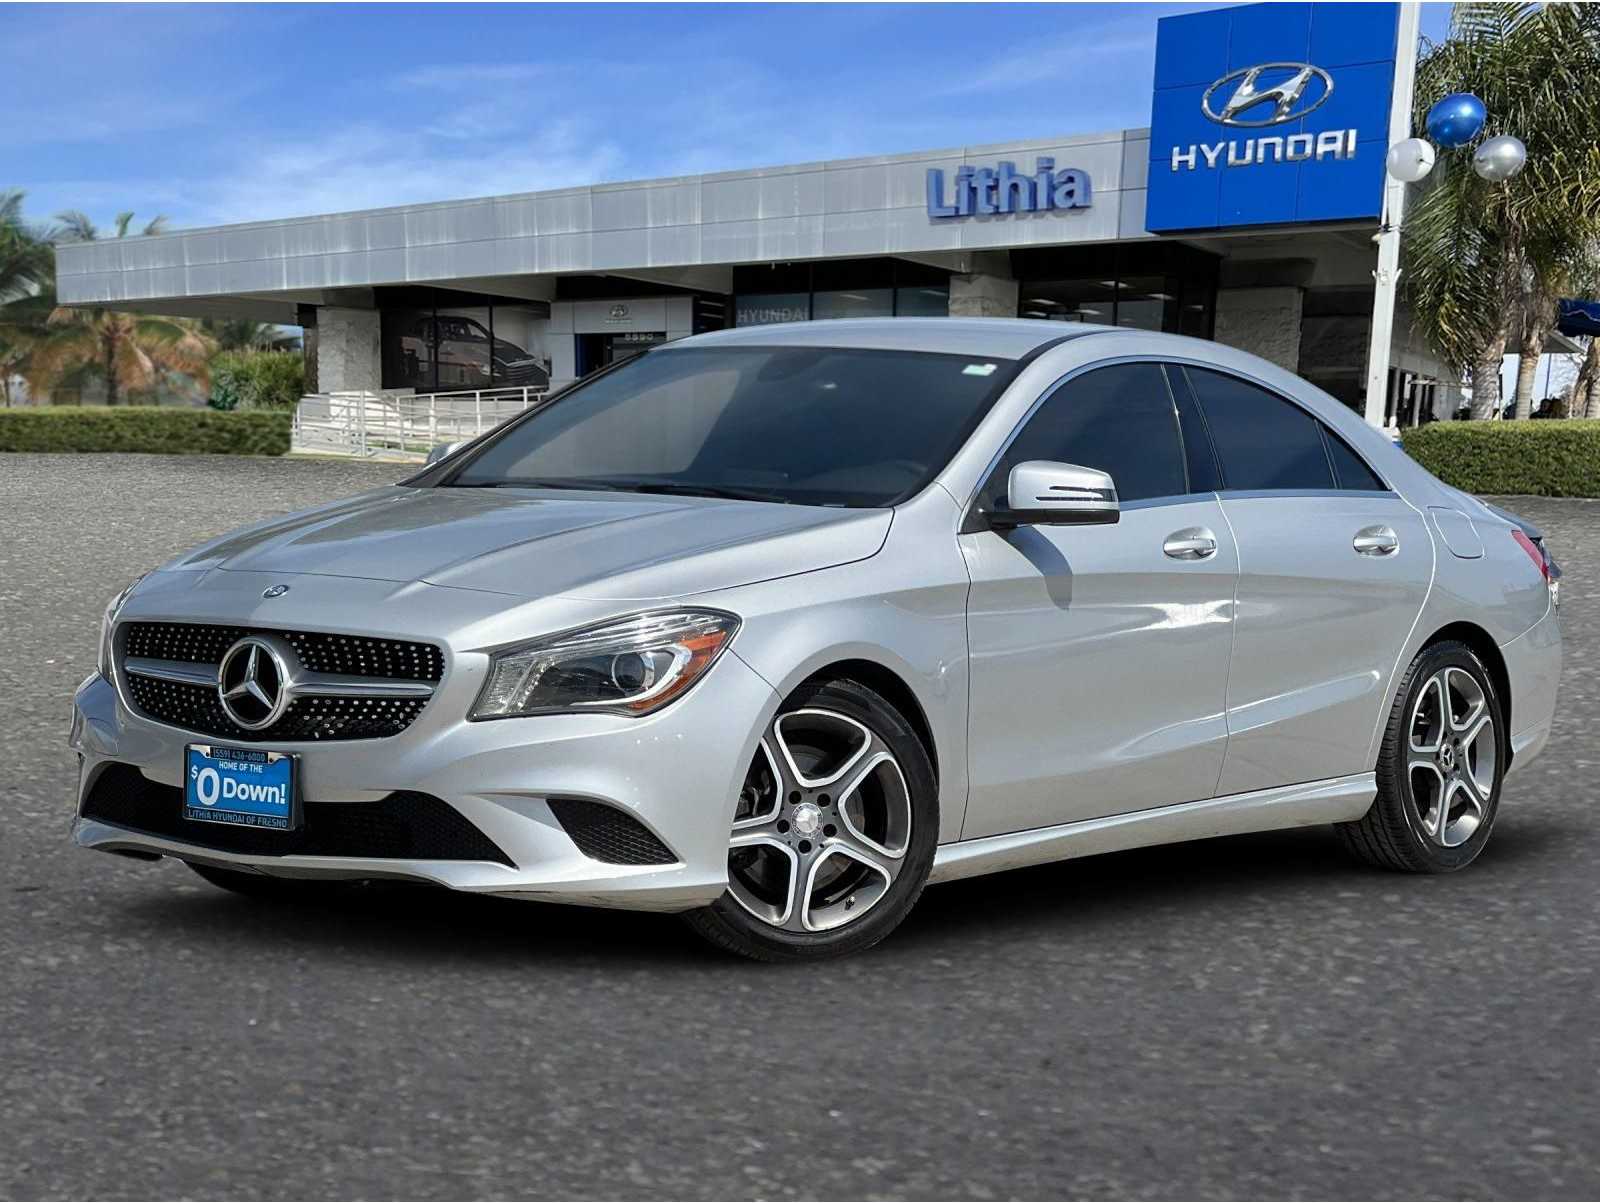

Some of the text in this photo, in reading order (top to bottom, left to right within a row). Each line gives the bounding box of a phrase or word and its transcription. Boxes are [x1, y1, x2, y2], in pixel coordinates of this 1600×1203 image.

[1171, 129, 1357, 171] HYUNDAI
[927, 157, 1092, 218] Lithia
[737, 308, 809, 322] HYUNDAI
[219, 761, 263, 773] HOME OF THE
[222, 777, 286, 804] Down!
[188, 808, 288, 829] LITHIA HYUNDAI OF FRESNO
